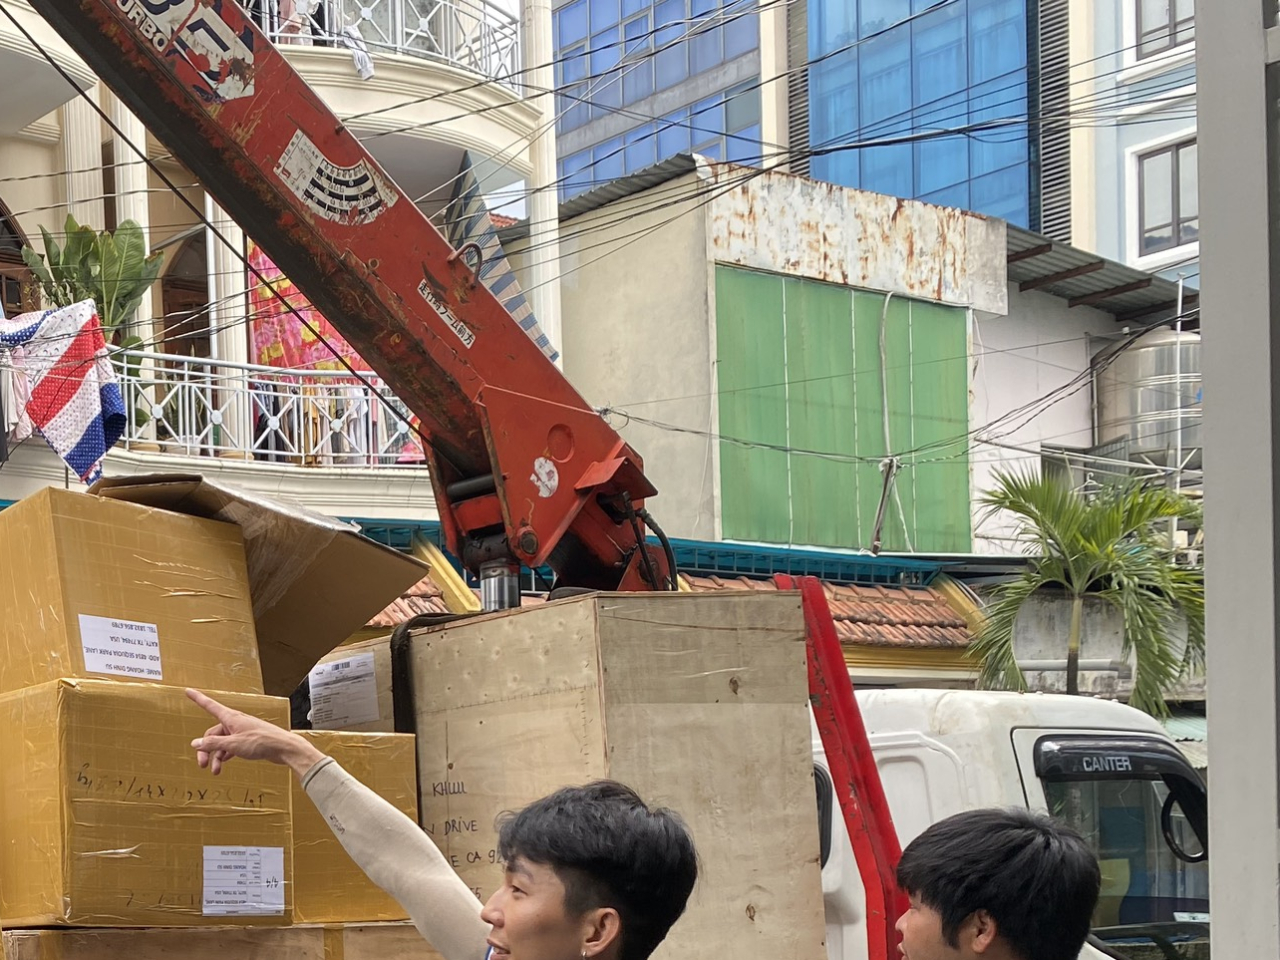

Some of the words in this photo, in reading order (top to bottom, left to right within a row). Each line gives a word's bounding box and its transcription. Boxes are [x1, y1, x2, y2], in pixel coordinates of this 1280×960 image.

[100, 648, 112, 656] PARK
[113, 650, 135, 659] SEQUOIA
[1083, 756, 1132, 772] CANTER
[466, 851, 482, 864] CA
